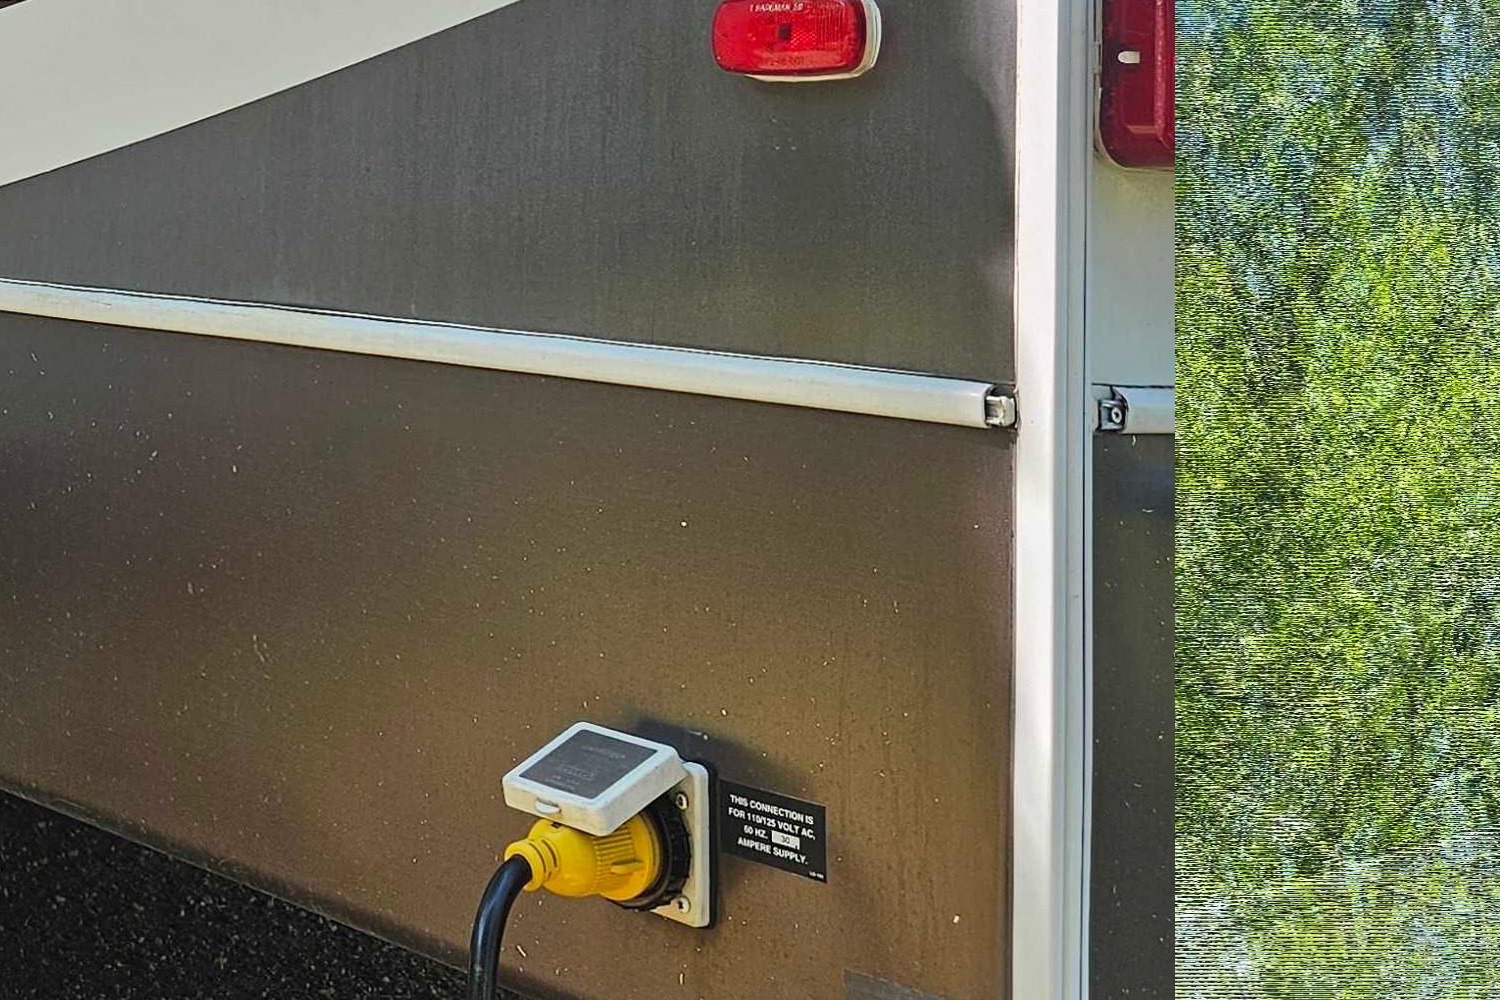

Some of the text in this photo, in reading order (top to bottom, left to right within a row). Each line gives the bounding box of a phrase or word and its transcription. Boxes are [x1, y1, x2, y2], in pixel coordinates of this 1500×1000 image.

[728, 807, 746, 819] FOR
[777, 820, 800, 834] VOLT
[729, 794, 814, 825] THIS CONNECTION IS
[738, 836, 808, 865] AMPERE SUPPLY.
